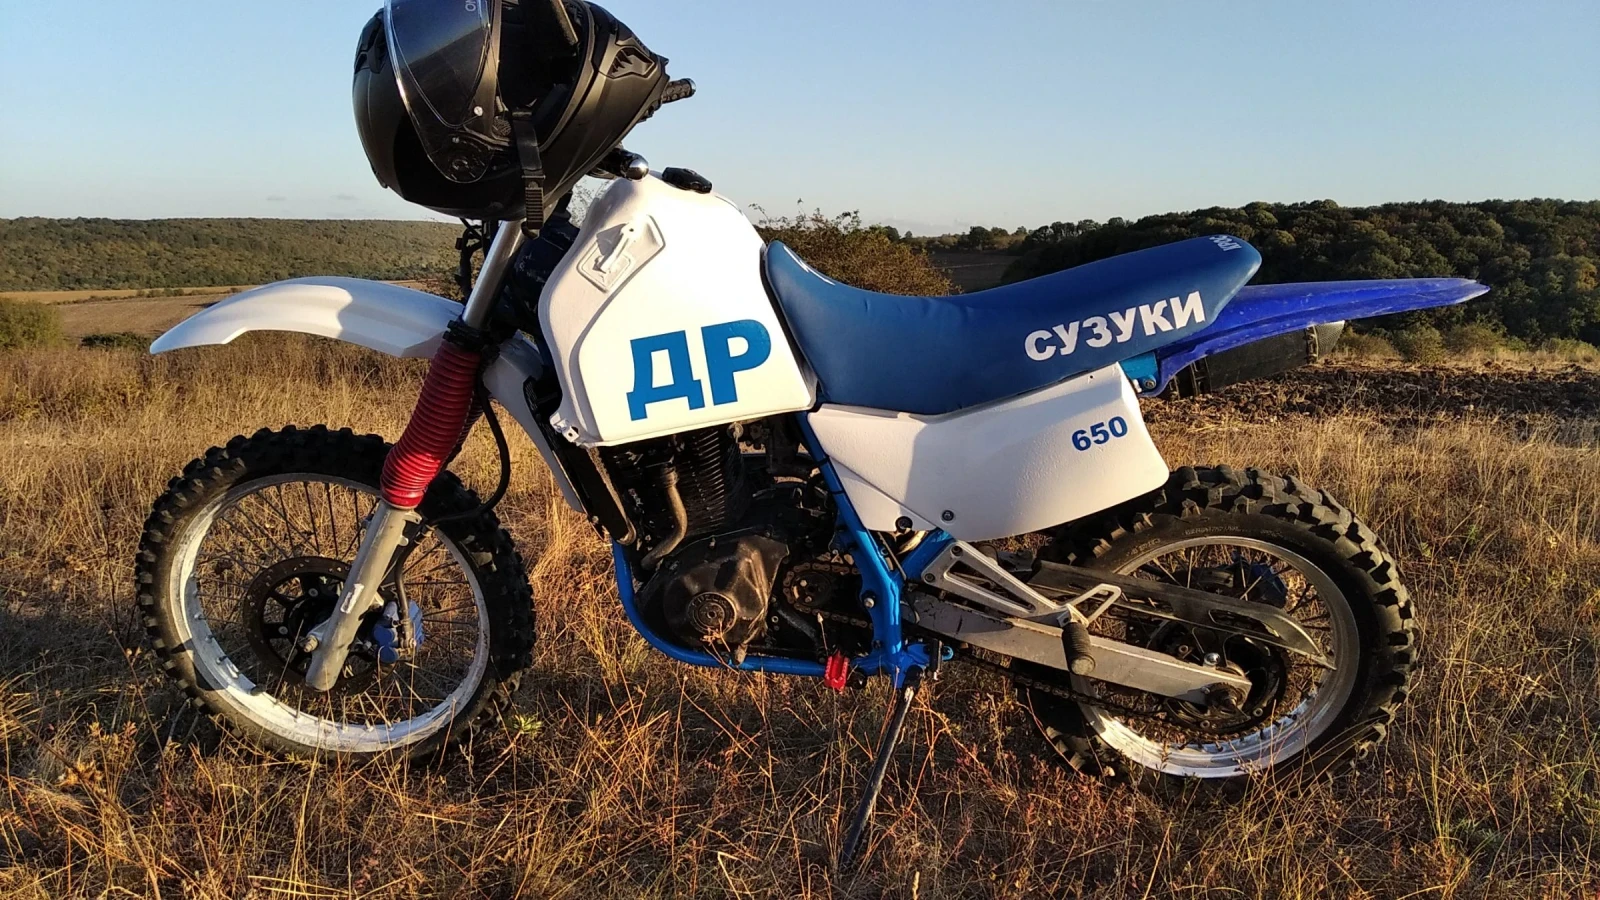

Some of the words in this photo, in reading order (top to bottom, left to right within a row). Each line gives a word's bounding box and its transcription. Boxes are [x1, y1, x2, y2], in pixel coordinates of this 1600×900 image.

[1024, 290, 1206, 361] СУЗУКИ
[626, 319, 772, 421] ДР
[1071, 415, 1128, 451] 650
